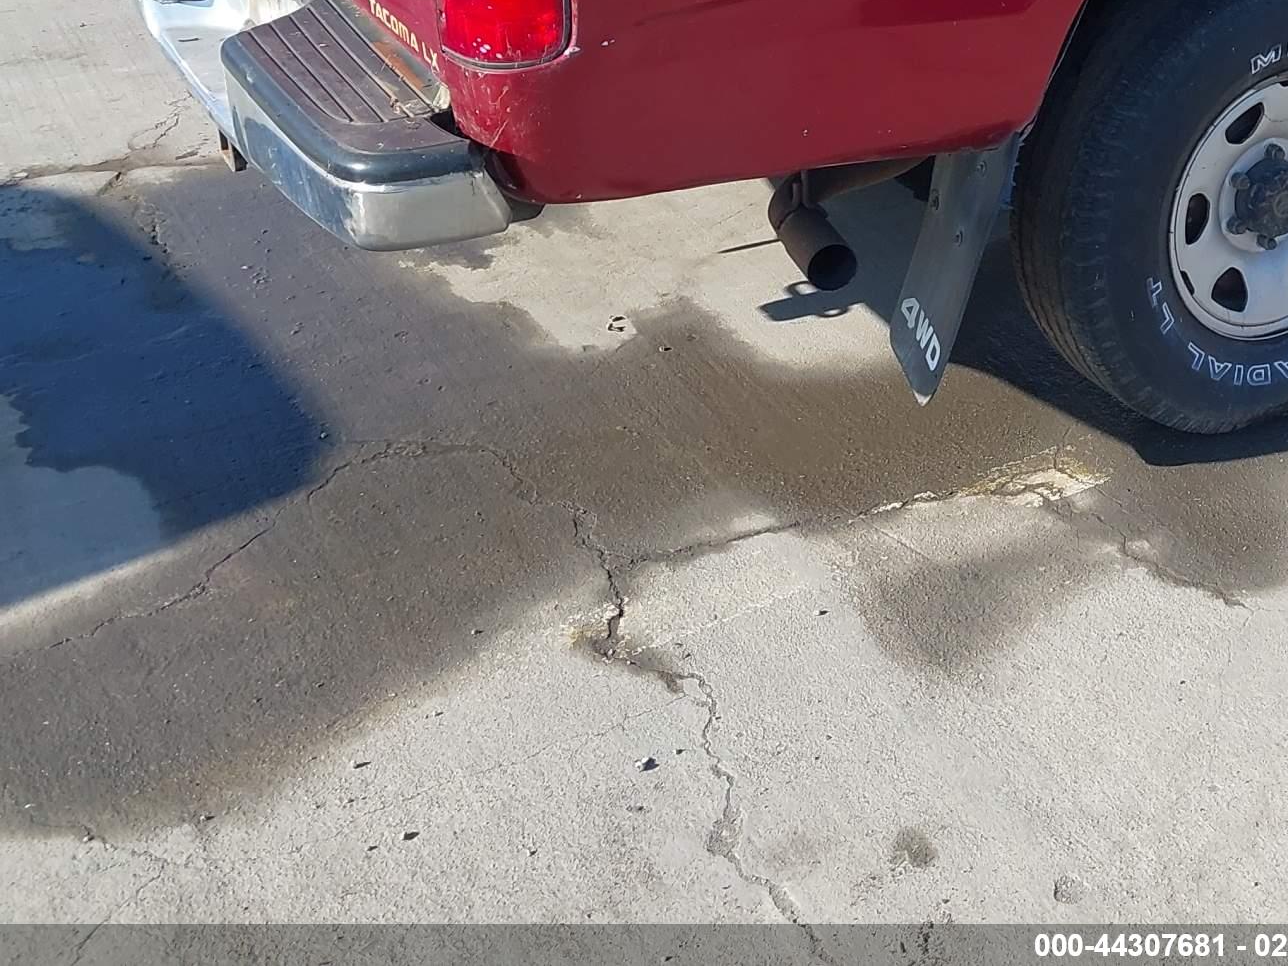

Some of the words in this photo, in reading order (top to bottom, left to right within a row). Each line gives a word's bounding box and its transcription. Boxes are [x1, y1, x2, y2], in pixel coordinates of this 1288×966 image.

[421, 41, 440, 74] LX
[900, 297, 941, 372] 4WD
[1146, 277, 1175, 335] LT
